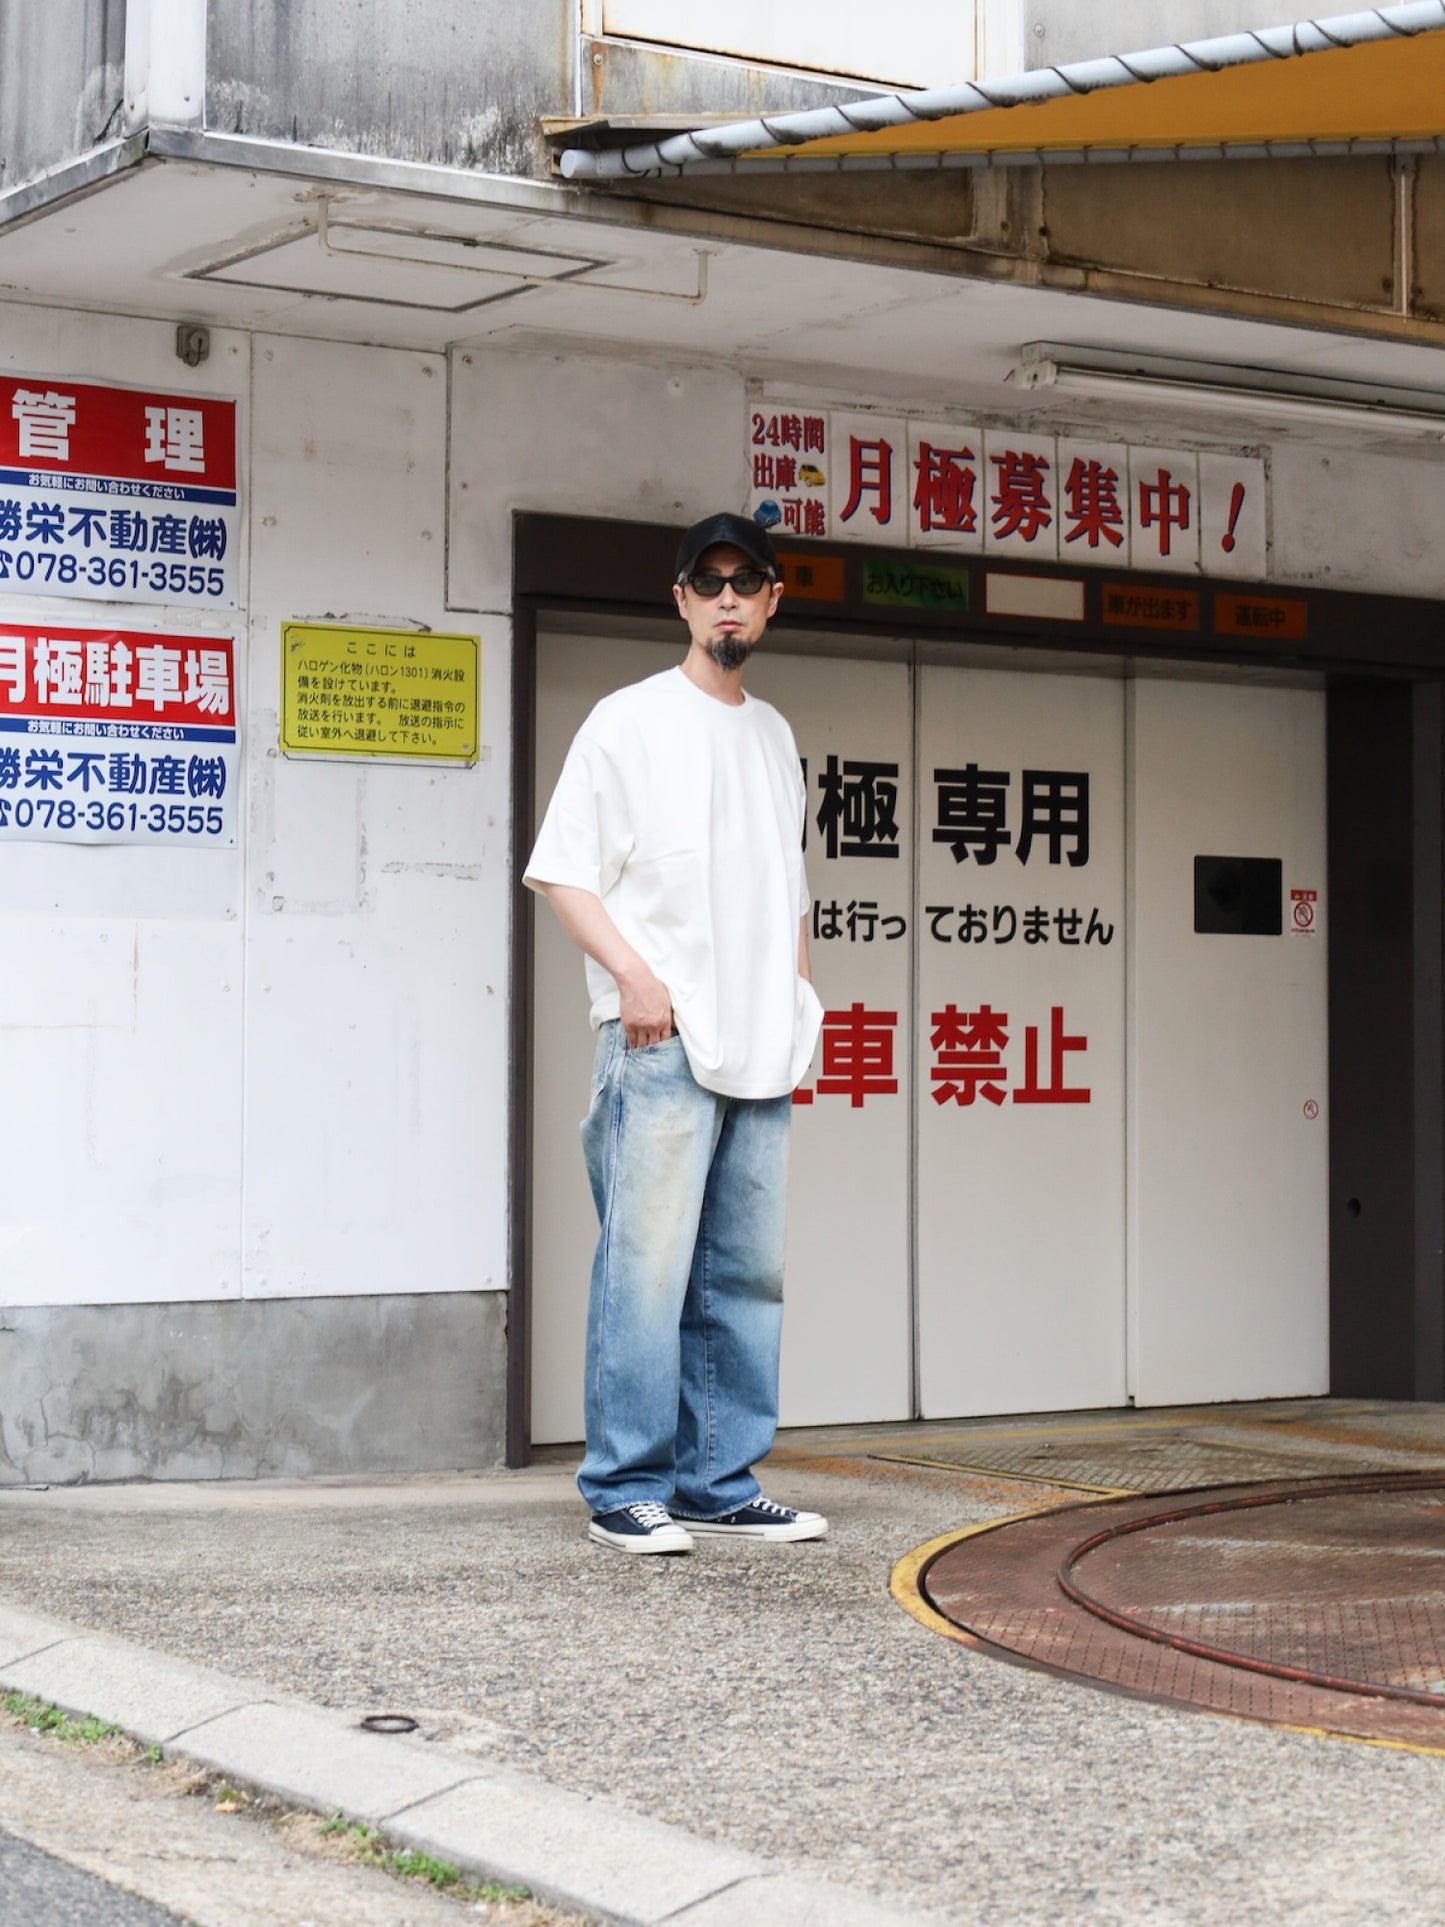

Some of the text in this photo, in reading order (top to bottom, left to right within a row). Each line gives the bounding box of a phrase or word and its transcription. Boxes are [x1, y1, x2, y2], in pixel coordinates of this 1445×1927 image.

[752, 413, 825, 453] 24時間
[28, 473, 185, 499] お気軽にお問い合わせください
[753, 453, 798, 491] 出庫
[781, 498, 825, 536] 可能
[16, 550, 224, 596] 078-361-3555
[866, 571, 964, 602] お入り下さい
[1108, 593, 1193, 623] 車が出ます
[1234, 604, 1286, 629] 運転中
[346, 641, 417, 658] ここには
[0, 636, 230, 715] 月極駐車場
[297, 675, 396, 695] 備を設けています。
[27, 719, 185, 740] お気軽にお問い合わせください
[297, 725, 438, 746] 従い室外へ退避して下さい。
[14, 798, 224, 835] 078-361-3555
